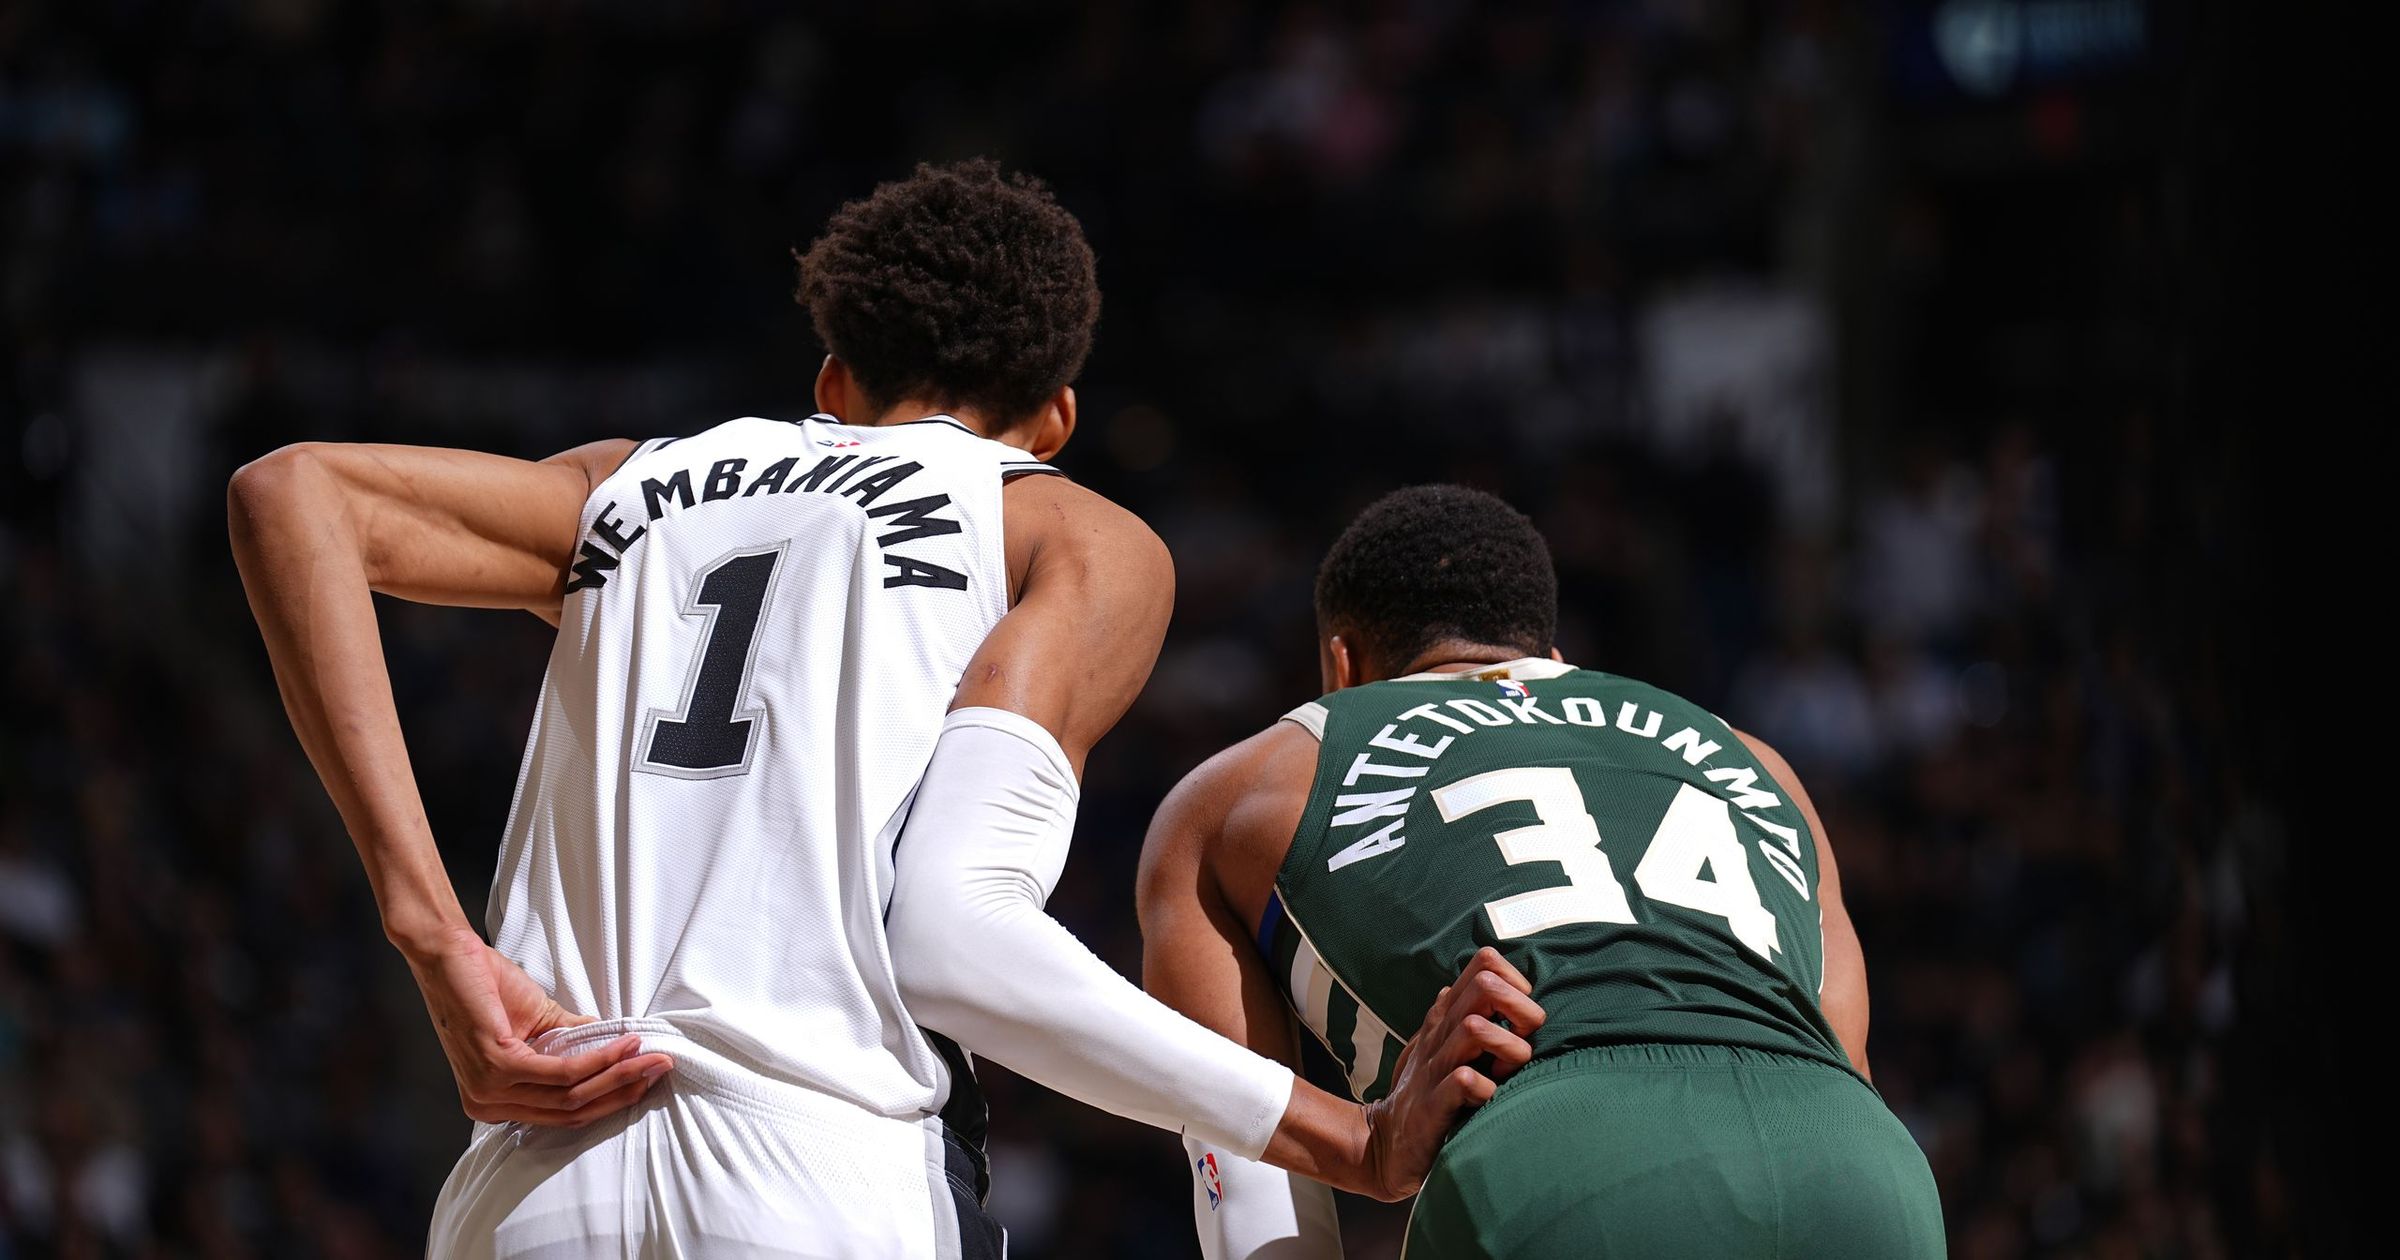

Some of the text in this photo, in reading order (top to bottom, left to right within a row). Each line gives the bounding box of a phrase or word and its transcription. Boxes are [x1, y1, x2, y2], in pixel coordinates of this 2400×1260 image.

[564, 454, 968, 595] WEMBANYAMA
[631, 538, 792, 781] 1
[1327, 696, 1811, 902] ANTETOKOUNMPO
[1430, 767, 1781, 964] 34
